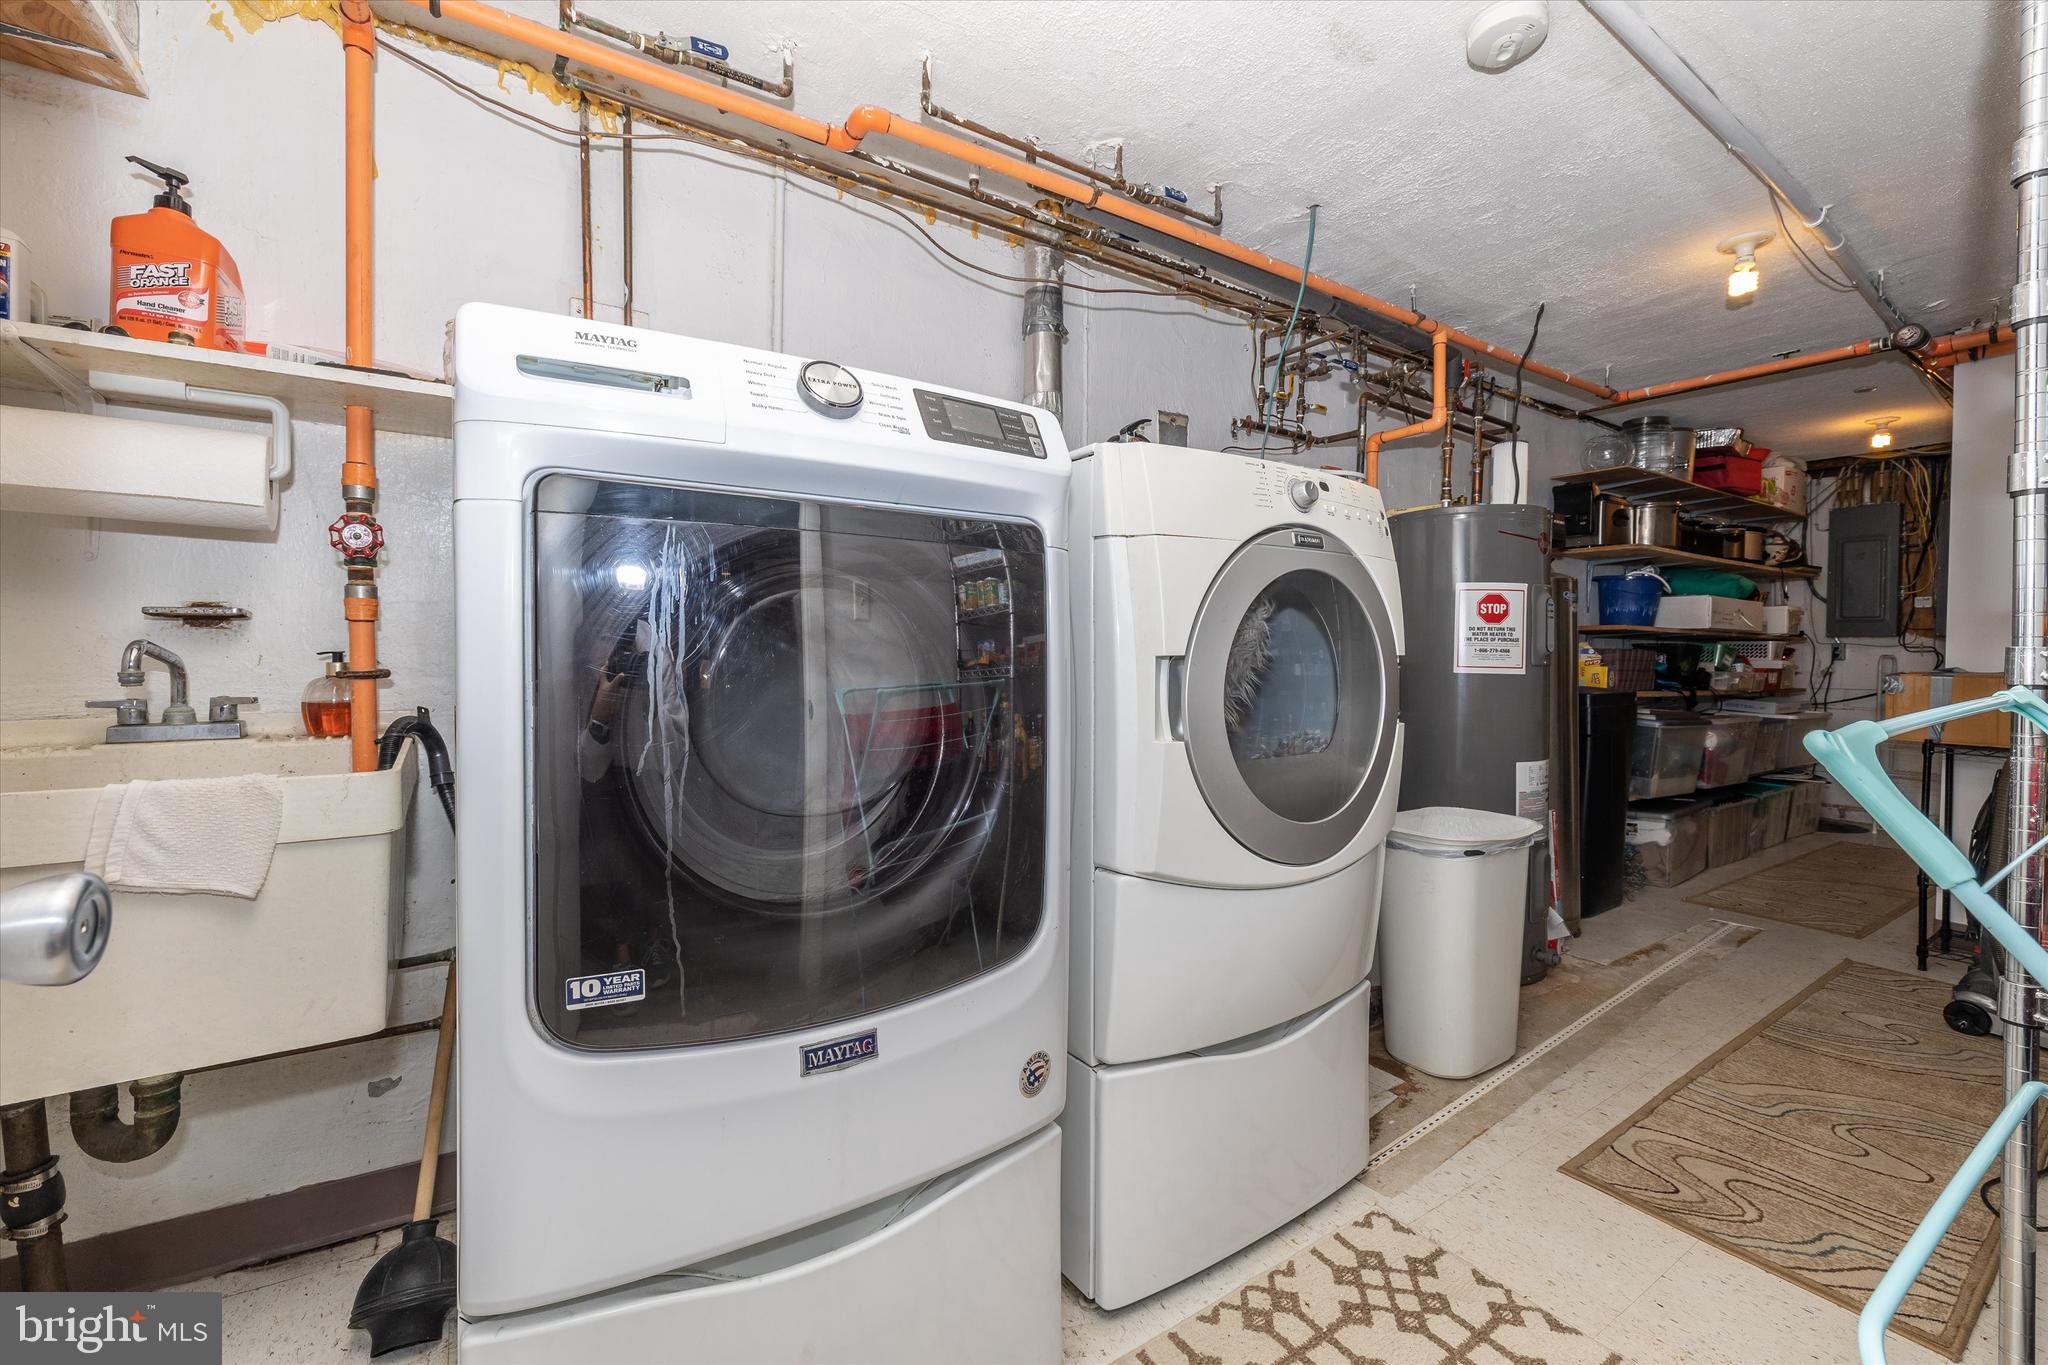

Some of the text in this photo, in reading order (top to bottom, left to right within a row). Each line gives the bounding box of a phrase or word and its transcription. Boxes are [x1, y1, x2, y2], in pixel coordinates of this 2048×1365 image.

[727, 72, 754, 85] WATER
[130, 262, 191, 279] FAST
[129, 276, 190, 288] ORANGE
[136, 299, 156, 308] Hand
[157, 302, 185, 314] Cleaner
[575, 331, 638, 348] MAYTAG
[807, 376, 857, 389] EXTRA POWER
[1480, 603, 1507, 614] STOP
[603, 973, 641, 985] YEAR
[570, 978, 601, 1000] 10
[602, 982, 623, 990] LIMITED
[602, 985, 641, 995] WARRANTY
[807, 1038, 875, 1068] MAYTAG
